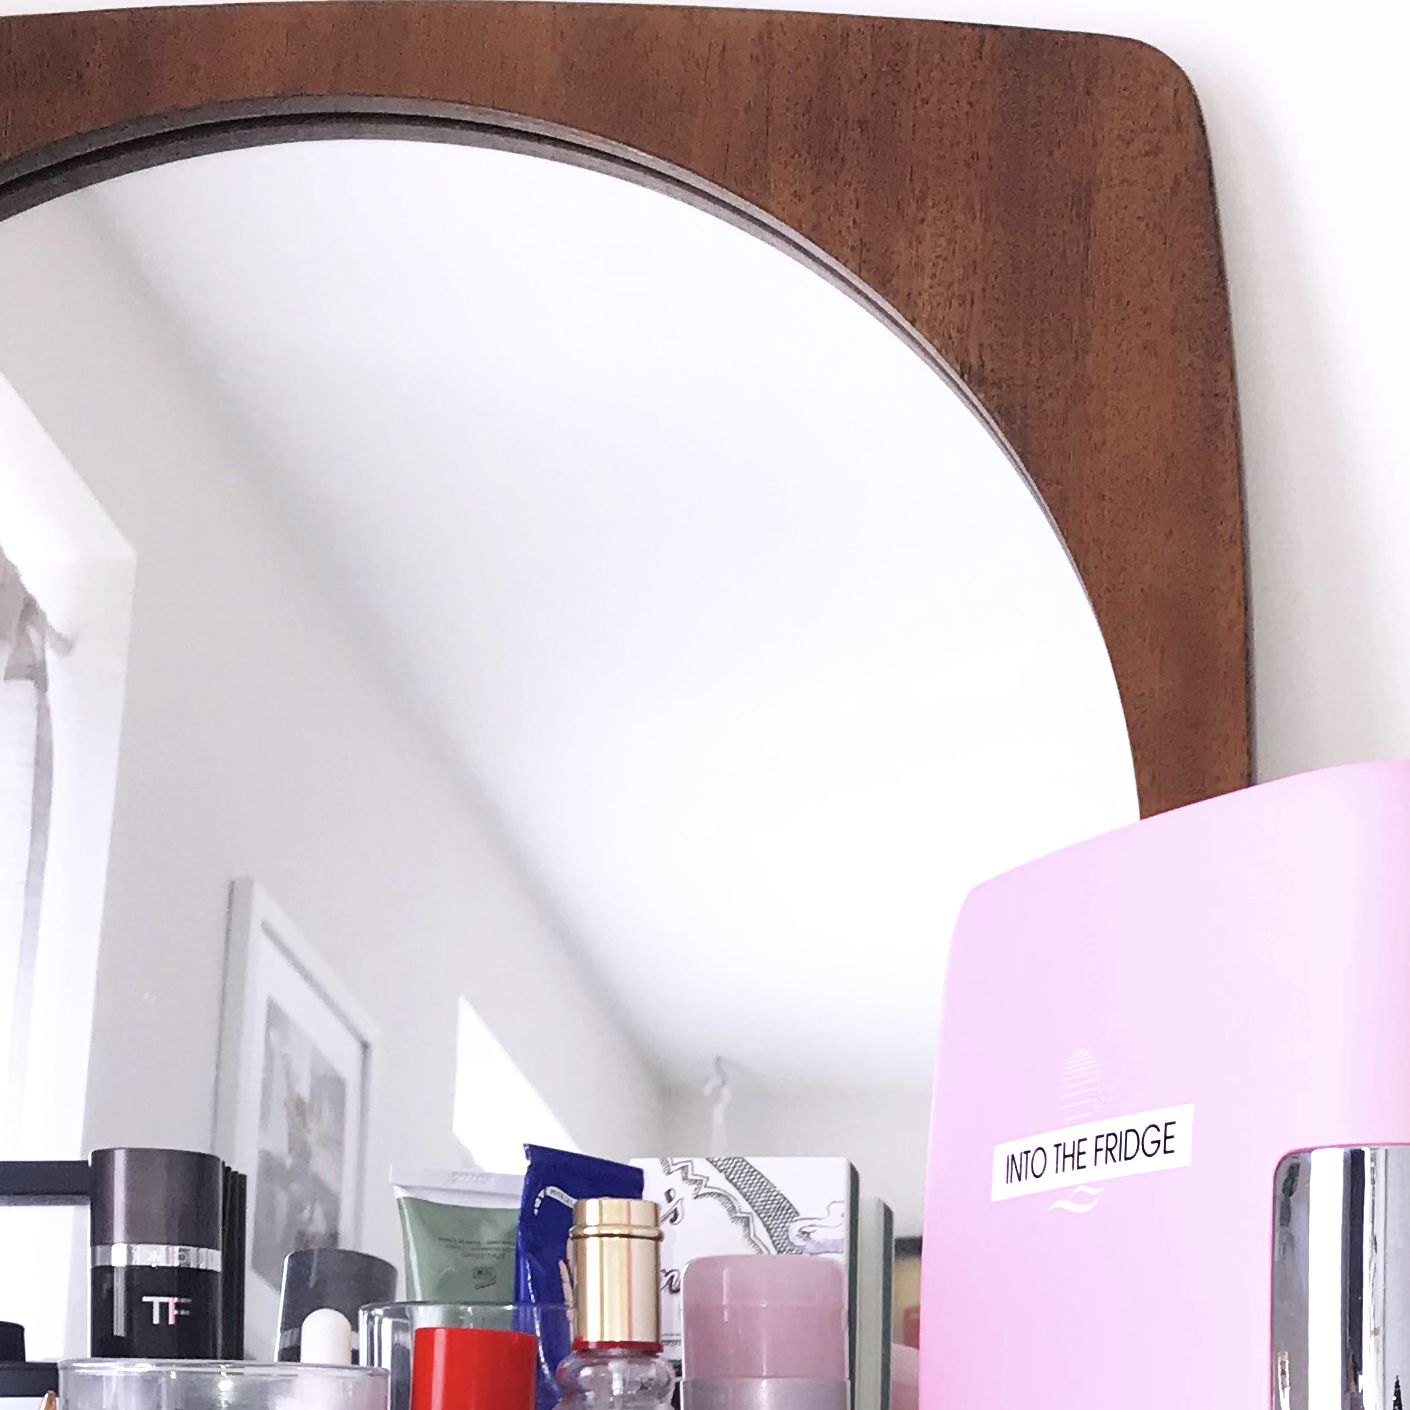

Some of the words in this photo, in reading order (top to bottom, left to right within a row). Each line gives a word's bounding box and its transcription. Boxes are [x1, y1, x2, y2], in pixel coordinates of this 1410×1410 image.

[1006, 1146, 1047, 1184] INTO
[1054, 1137, 1088, 1174] THE
[1094, 1121, 1177, 1167] FRIDGE
[142, 1295, 192, 1325] TF
